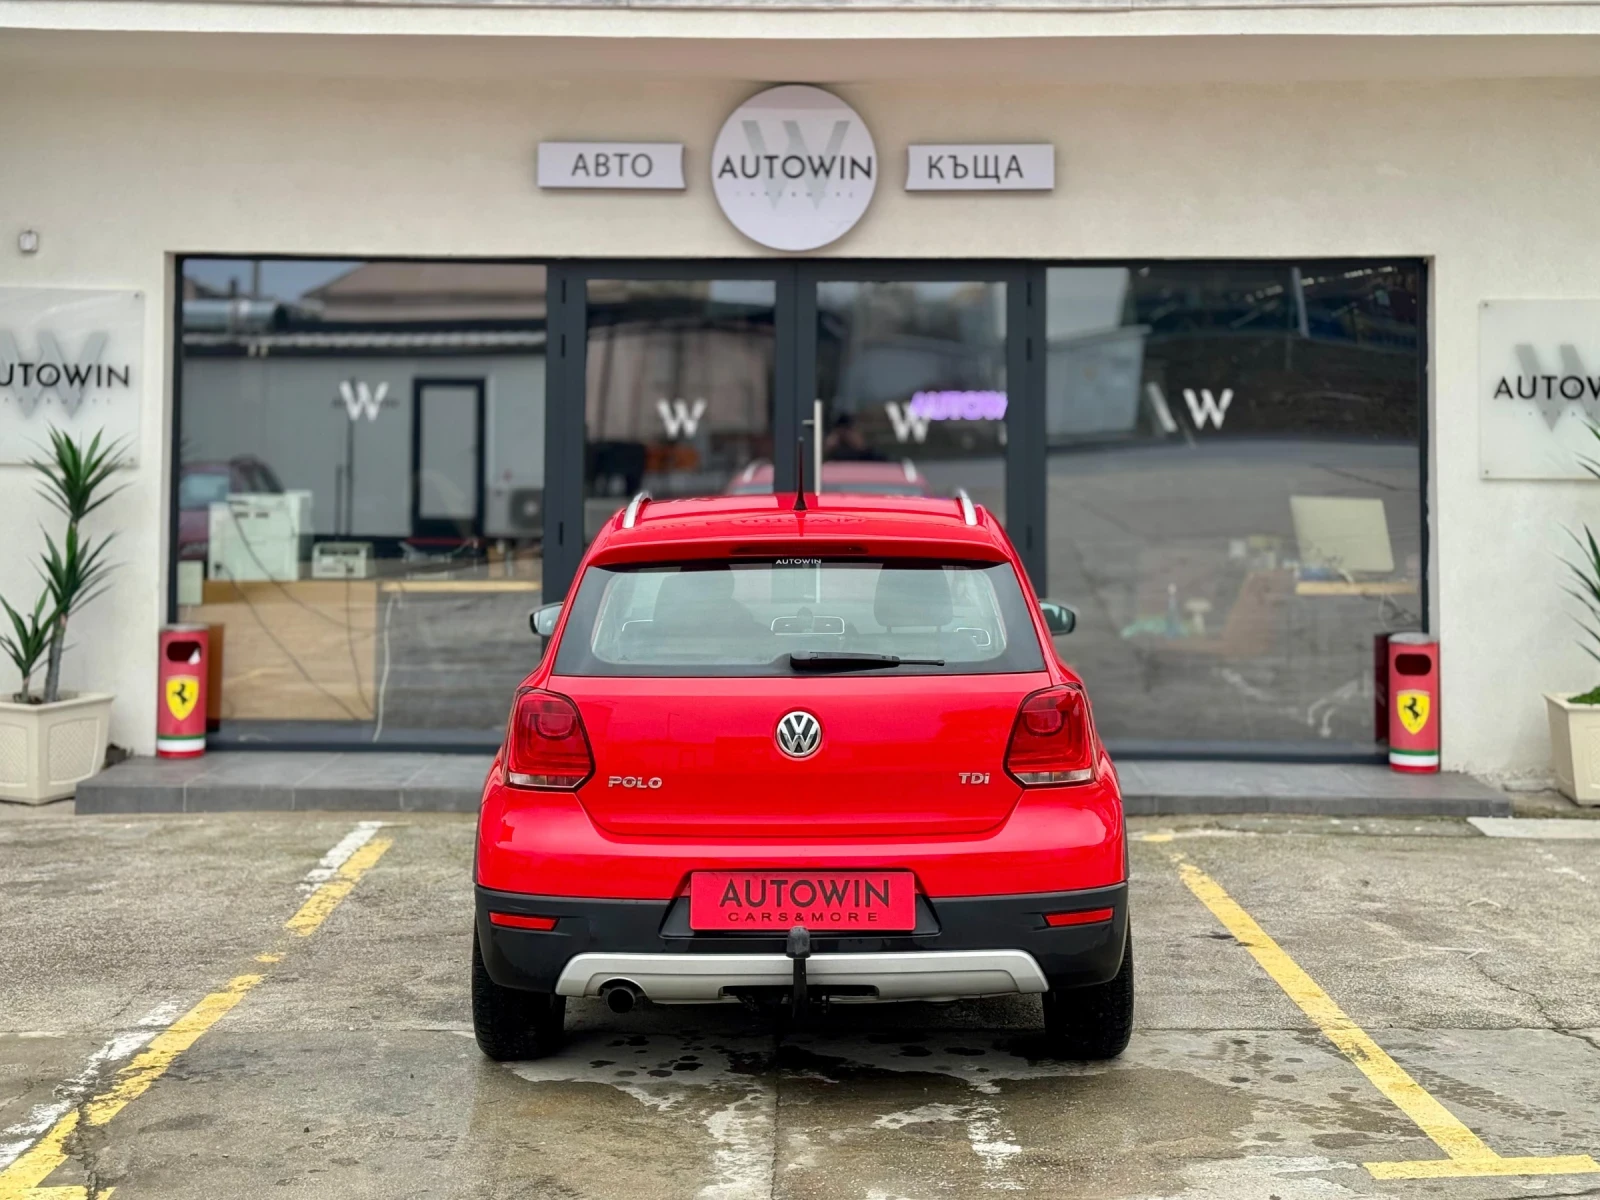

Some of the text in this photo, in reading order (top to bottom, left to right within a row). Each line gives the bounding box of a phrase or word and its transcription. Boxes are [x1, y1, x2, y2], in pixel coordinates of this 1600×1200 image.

[571, 153, 653, 178] АВТО
[718, 155, 873, 180] AUTOWIN
[928, 155, 1024, 184] КЪЩА
[340, 381, 389, 422] W
[1183, 389, 1234, 430] W
[657, 398, 708, 438] W
[883, 401, 932, 443] W
[608, 776, 662, 789] POLO
[719, 878, 889, 908] AUTOWIN
[727, 912, 879, 922] CARS&MORE
